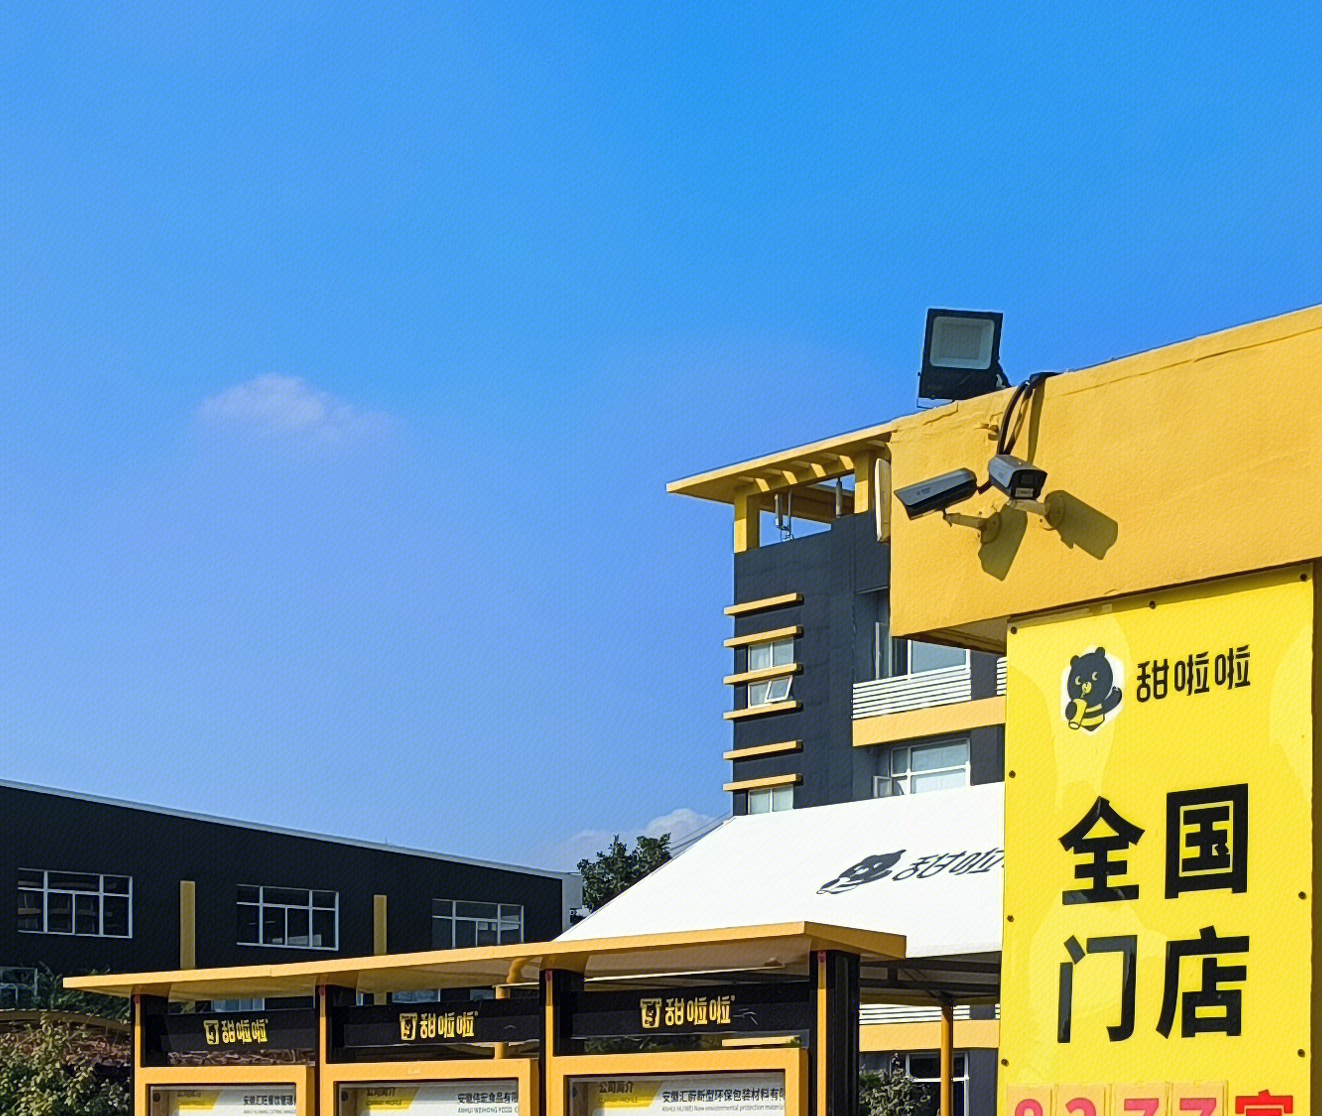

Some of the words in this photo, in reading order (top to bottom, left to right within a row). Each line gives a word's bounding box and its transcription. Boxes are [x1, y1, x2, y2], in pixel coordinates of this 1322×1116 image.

[1136, 644, 1251, 702] 甜啦啦
[1059, 783, 1249, 906] 全国
[891, 847, 1005, 882] 甜啦
[1057, 925, 1250, 1044] 门店
[419, 1011, 475, 1039] 甜啦啦
[665, 995, 731, 1026] 甜啦啦
[221, 1018, 269, 1044] 甜啦啦
